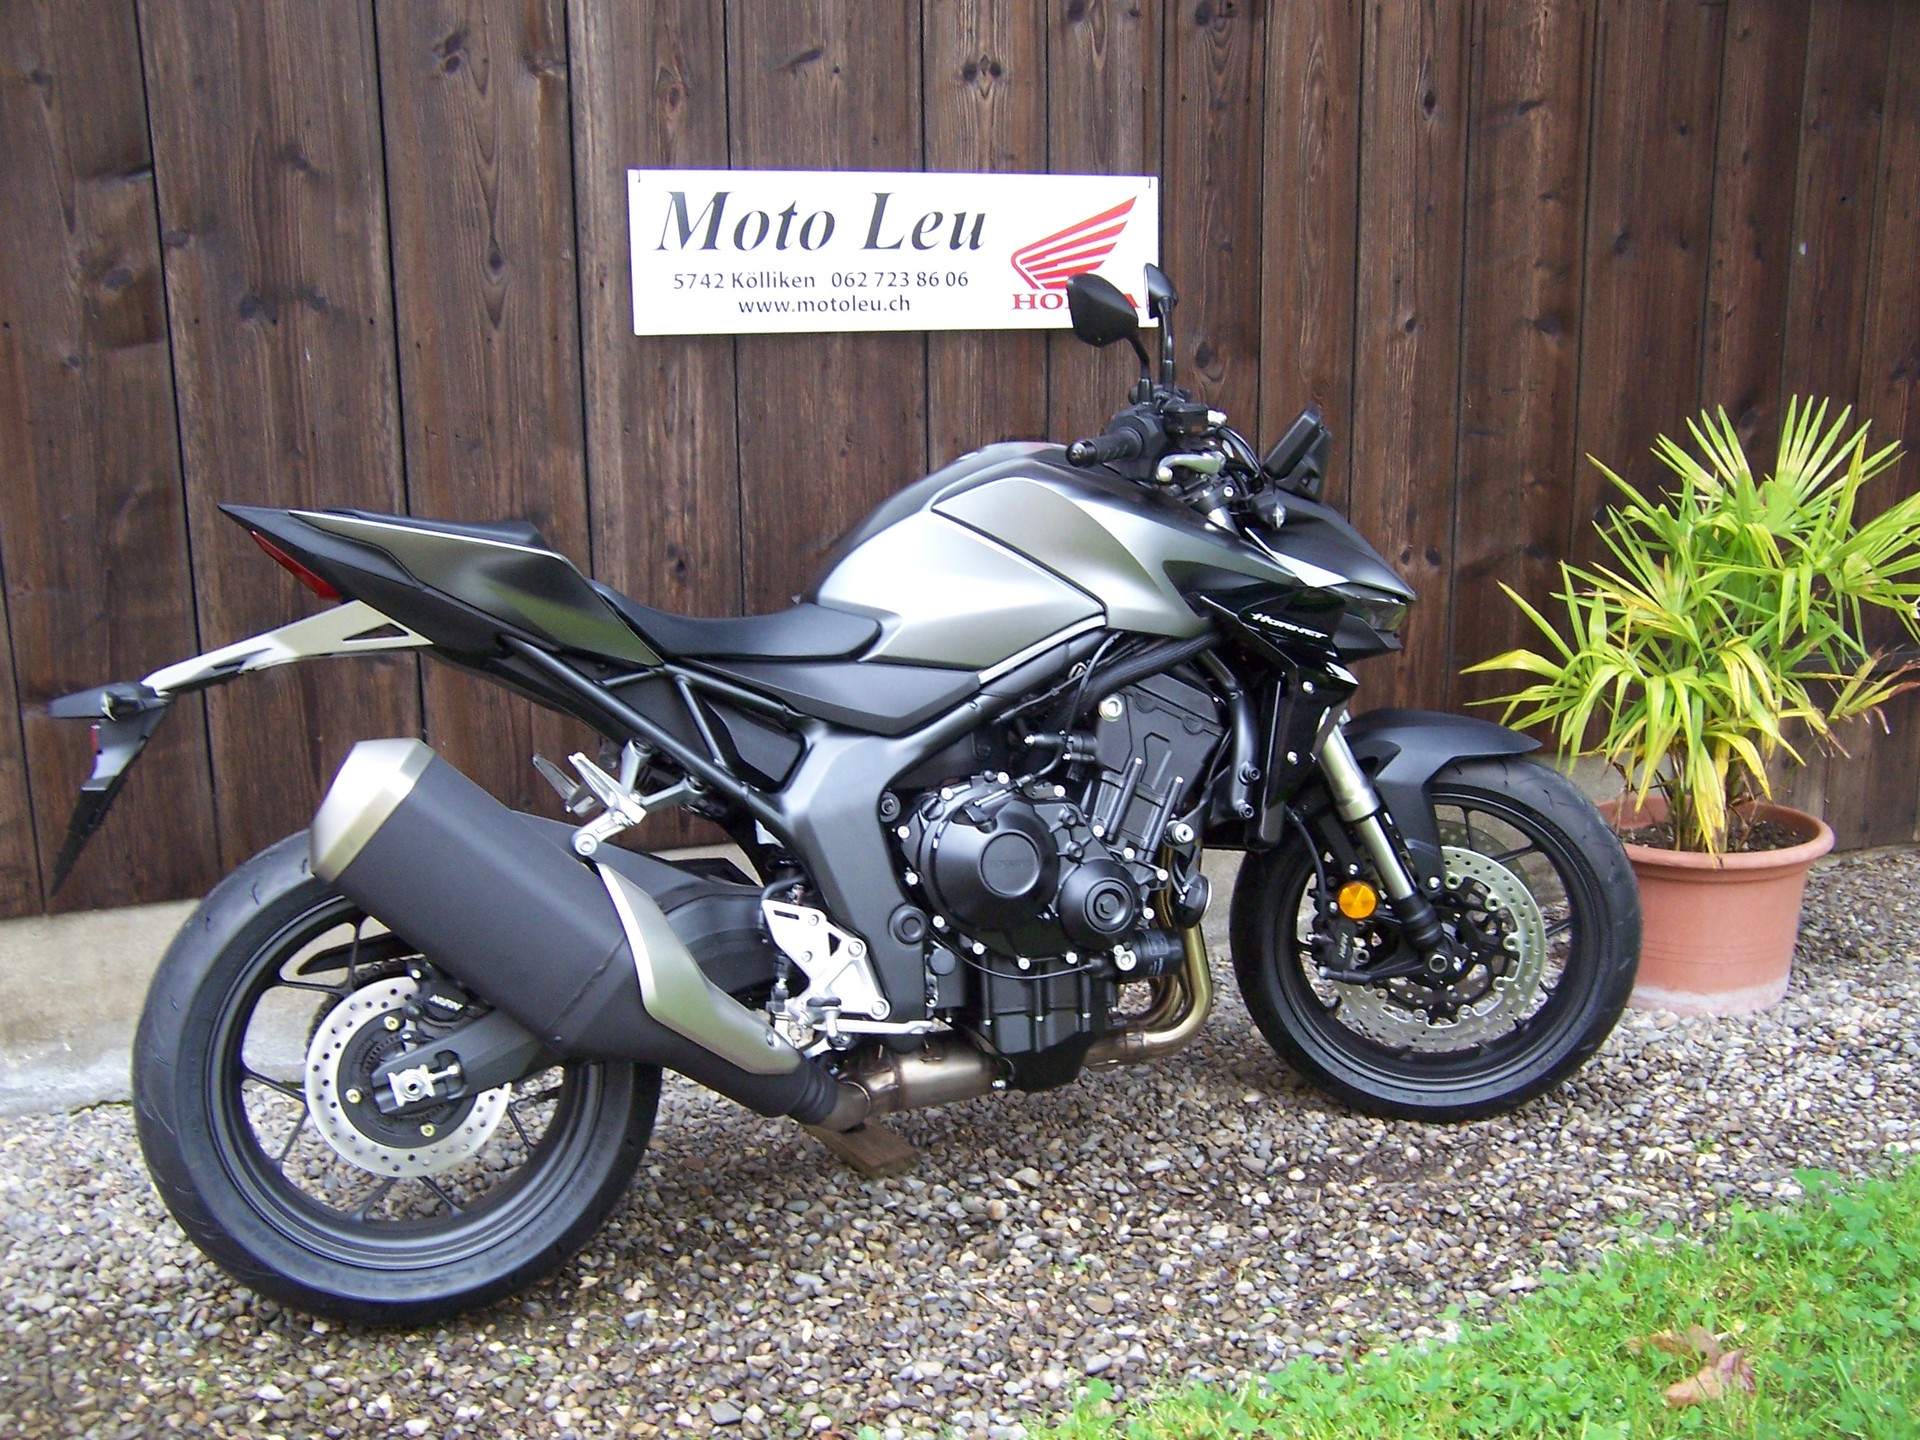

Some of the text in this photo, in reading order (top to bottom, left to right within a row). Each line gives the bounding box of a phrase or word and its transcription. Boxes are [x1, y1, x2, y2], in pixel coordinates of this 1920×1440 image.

[654, 191, 986, 251] Moto Leu
[673, 271, 969, 290] 5742 Kölliken 062 723 86 06
[738, 294, 911, 314] www.motoleu.ch
